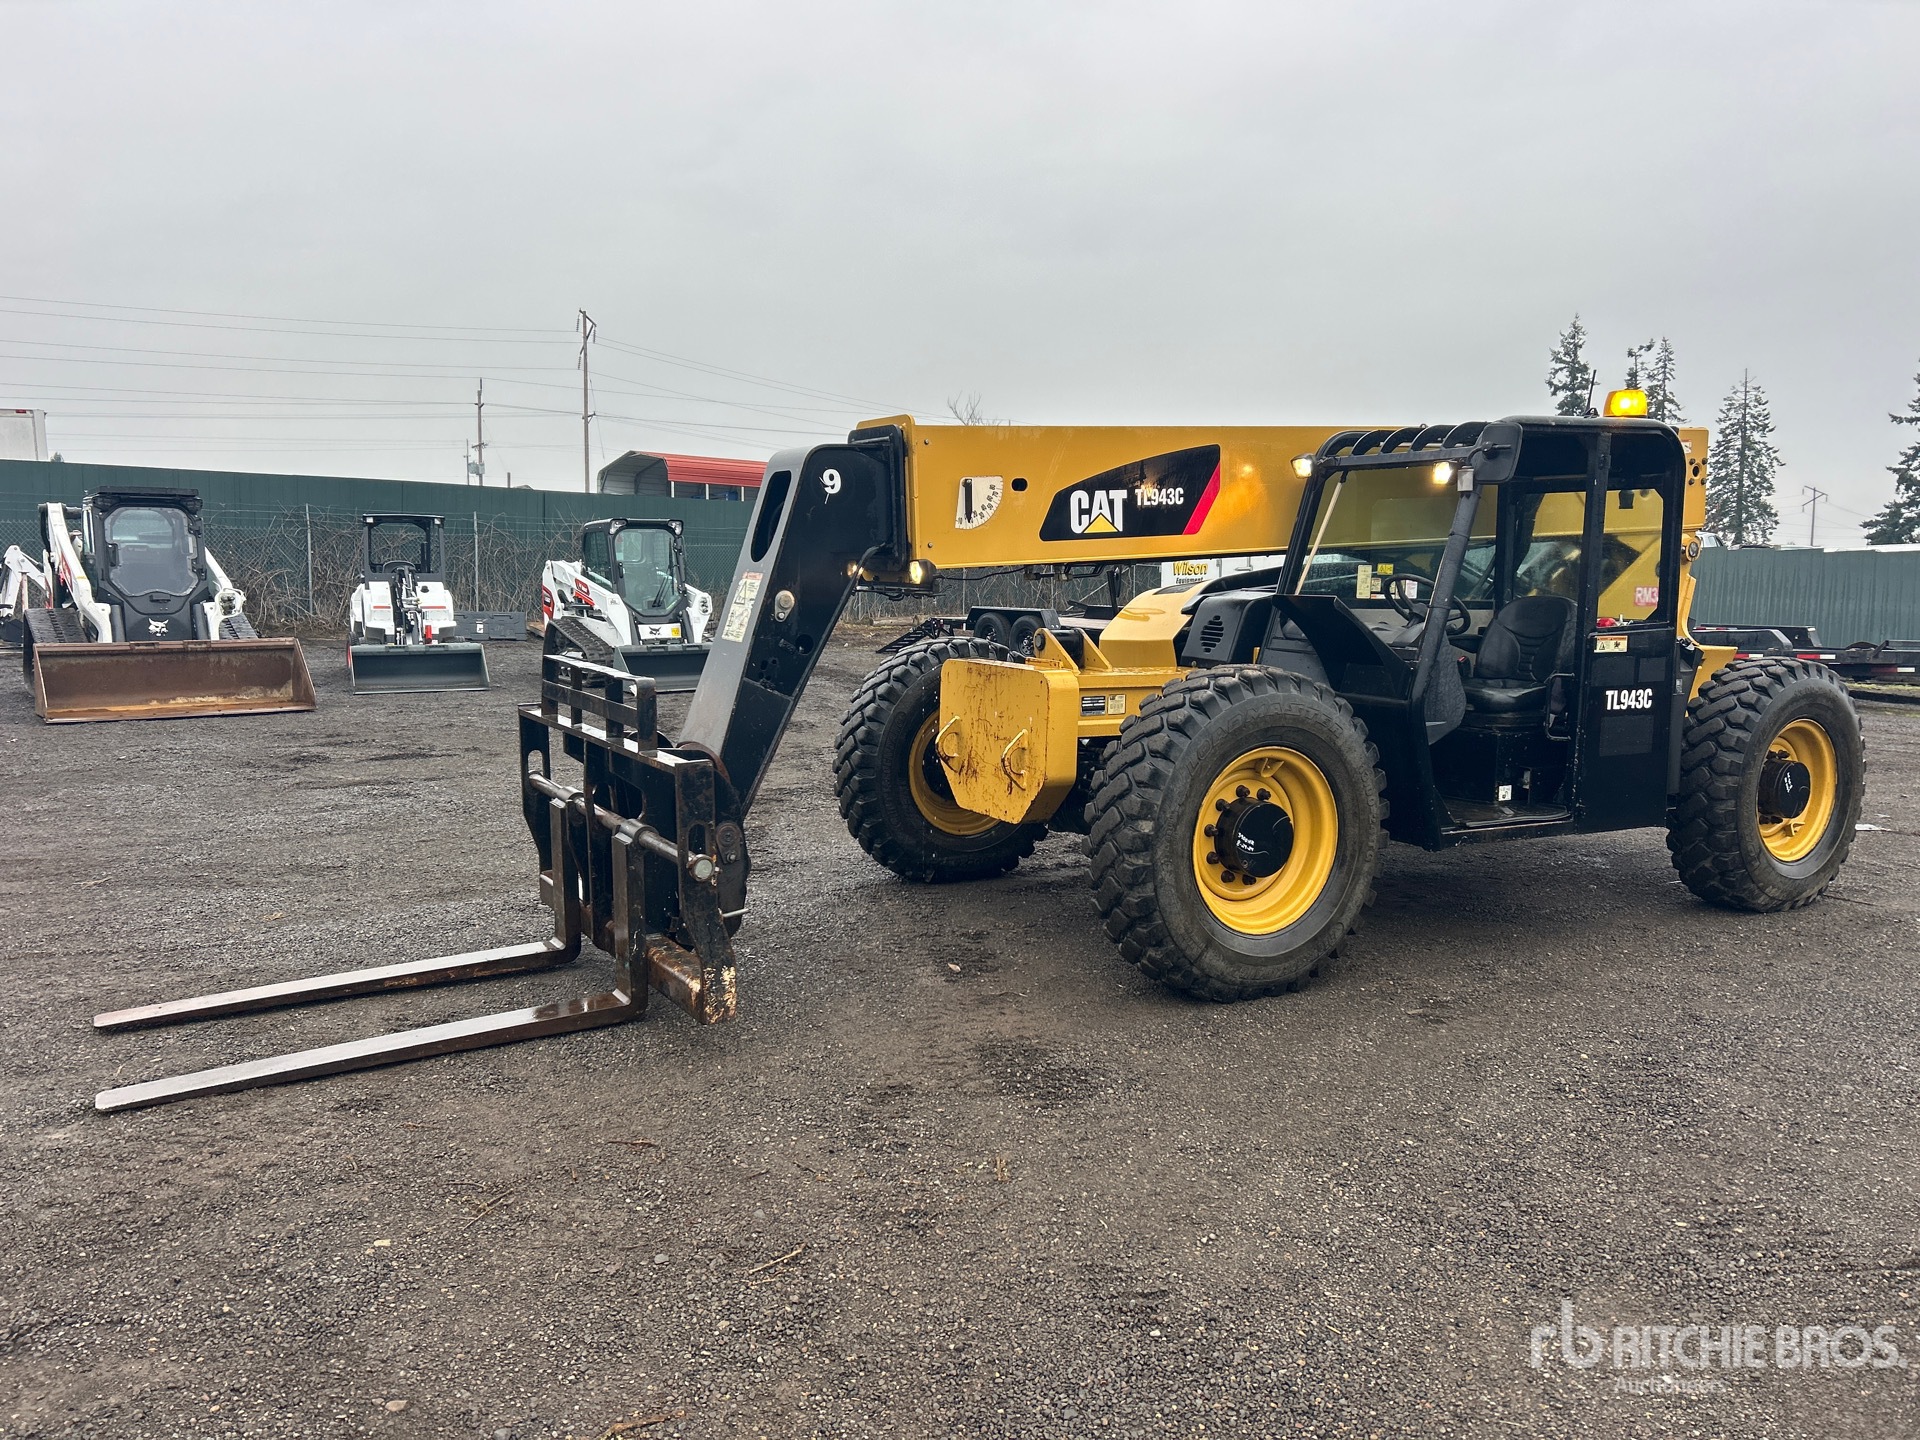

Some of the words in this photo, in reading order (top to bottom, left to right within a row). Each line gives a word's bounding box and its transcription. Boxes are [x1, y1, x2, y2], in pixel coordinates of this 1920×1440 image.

[822, 468, 842, 494] 9
[1135, 487, 1184, 506] TL943C
[1070, 490, 1127, 534] CAT
[1173, 561, 1208, 576] Wilson
[1605, 688, 1653, 710] TL943C
